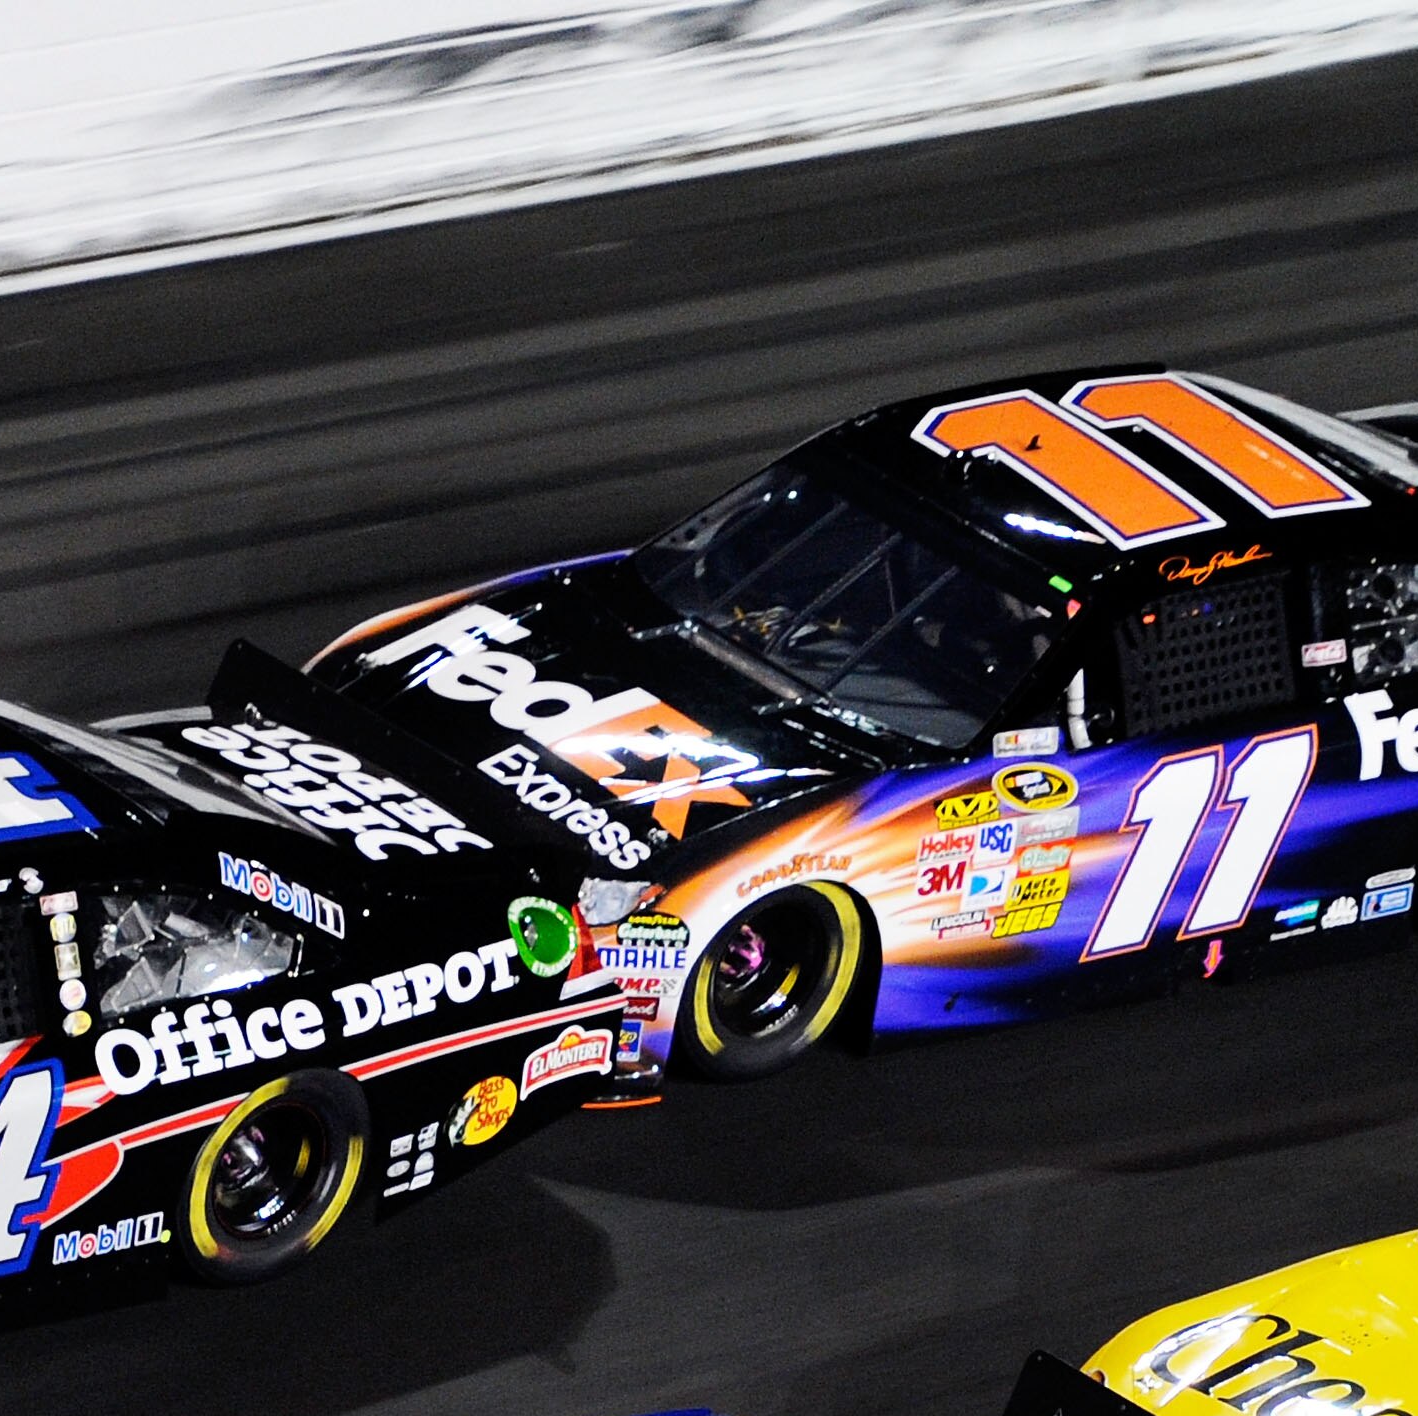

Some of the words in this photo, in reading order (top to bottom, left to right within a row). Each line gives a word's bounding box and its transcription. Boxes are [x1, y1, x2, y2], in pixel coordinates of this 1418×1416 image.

[910, 372, 1372, 551] 11
[360, 604, 757, 840] FedEx
[478, 744, 652, 870] Express
[920, 833, 975, 858] Holley
[980, 823, 1013, 854] USG
[1079, 724, 1317, 962] 11
[218, 851, 315, 924] Mobil
[918, 861, 967, 896] 3M
[1021, 887, 1061, 902] Meter
[1026, 877, 1057, 891] Auto
[991, 903, 1062, 939] JEGS
[599, 947, 686, 969] MAHLE
[614, 977, 660, 992] OMP
[95, 999, 325, 1095] Office
[332, 939, 520, 1038] DEPOT
[52, 1219, 133, 1265] Mobil
[135, 1211, 164, 1248] 1
